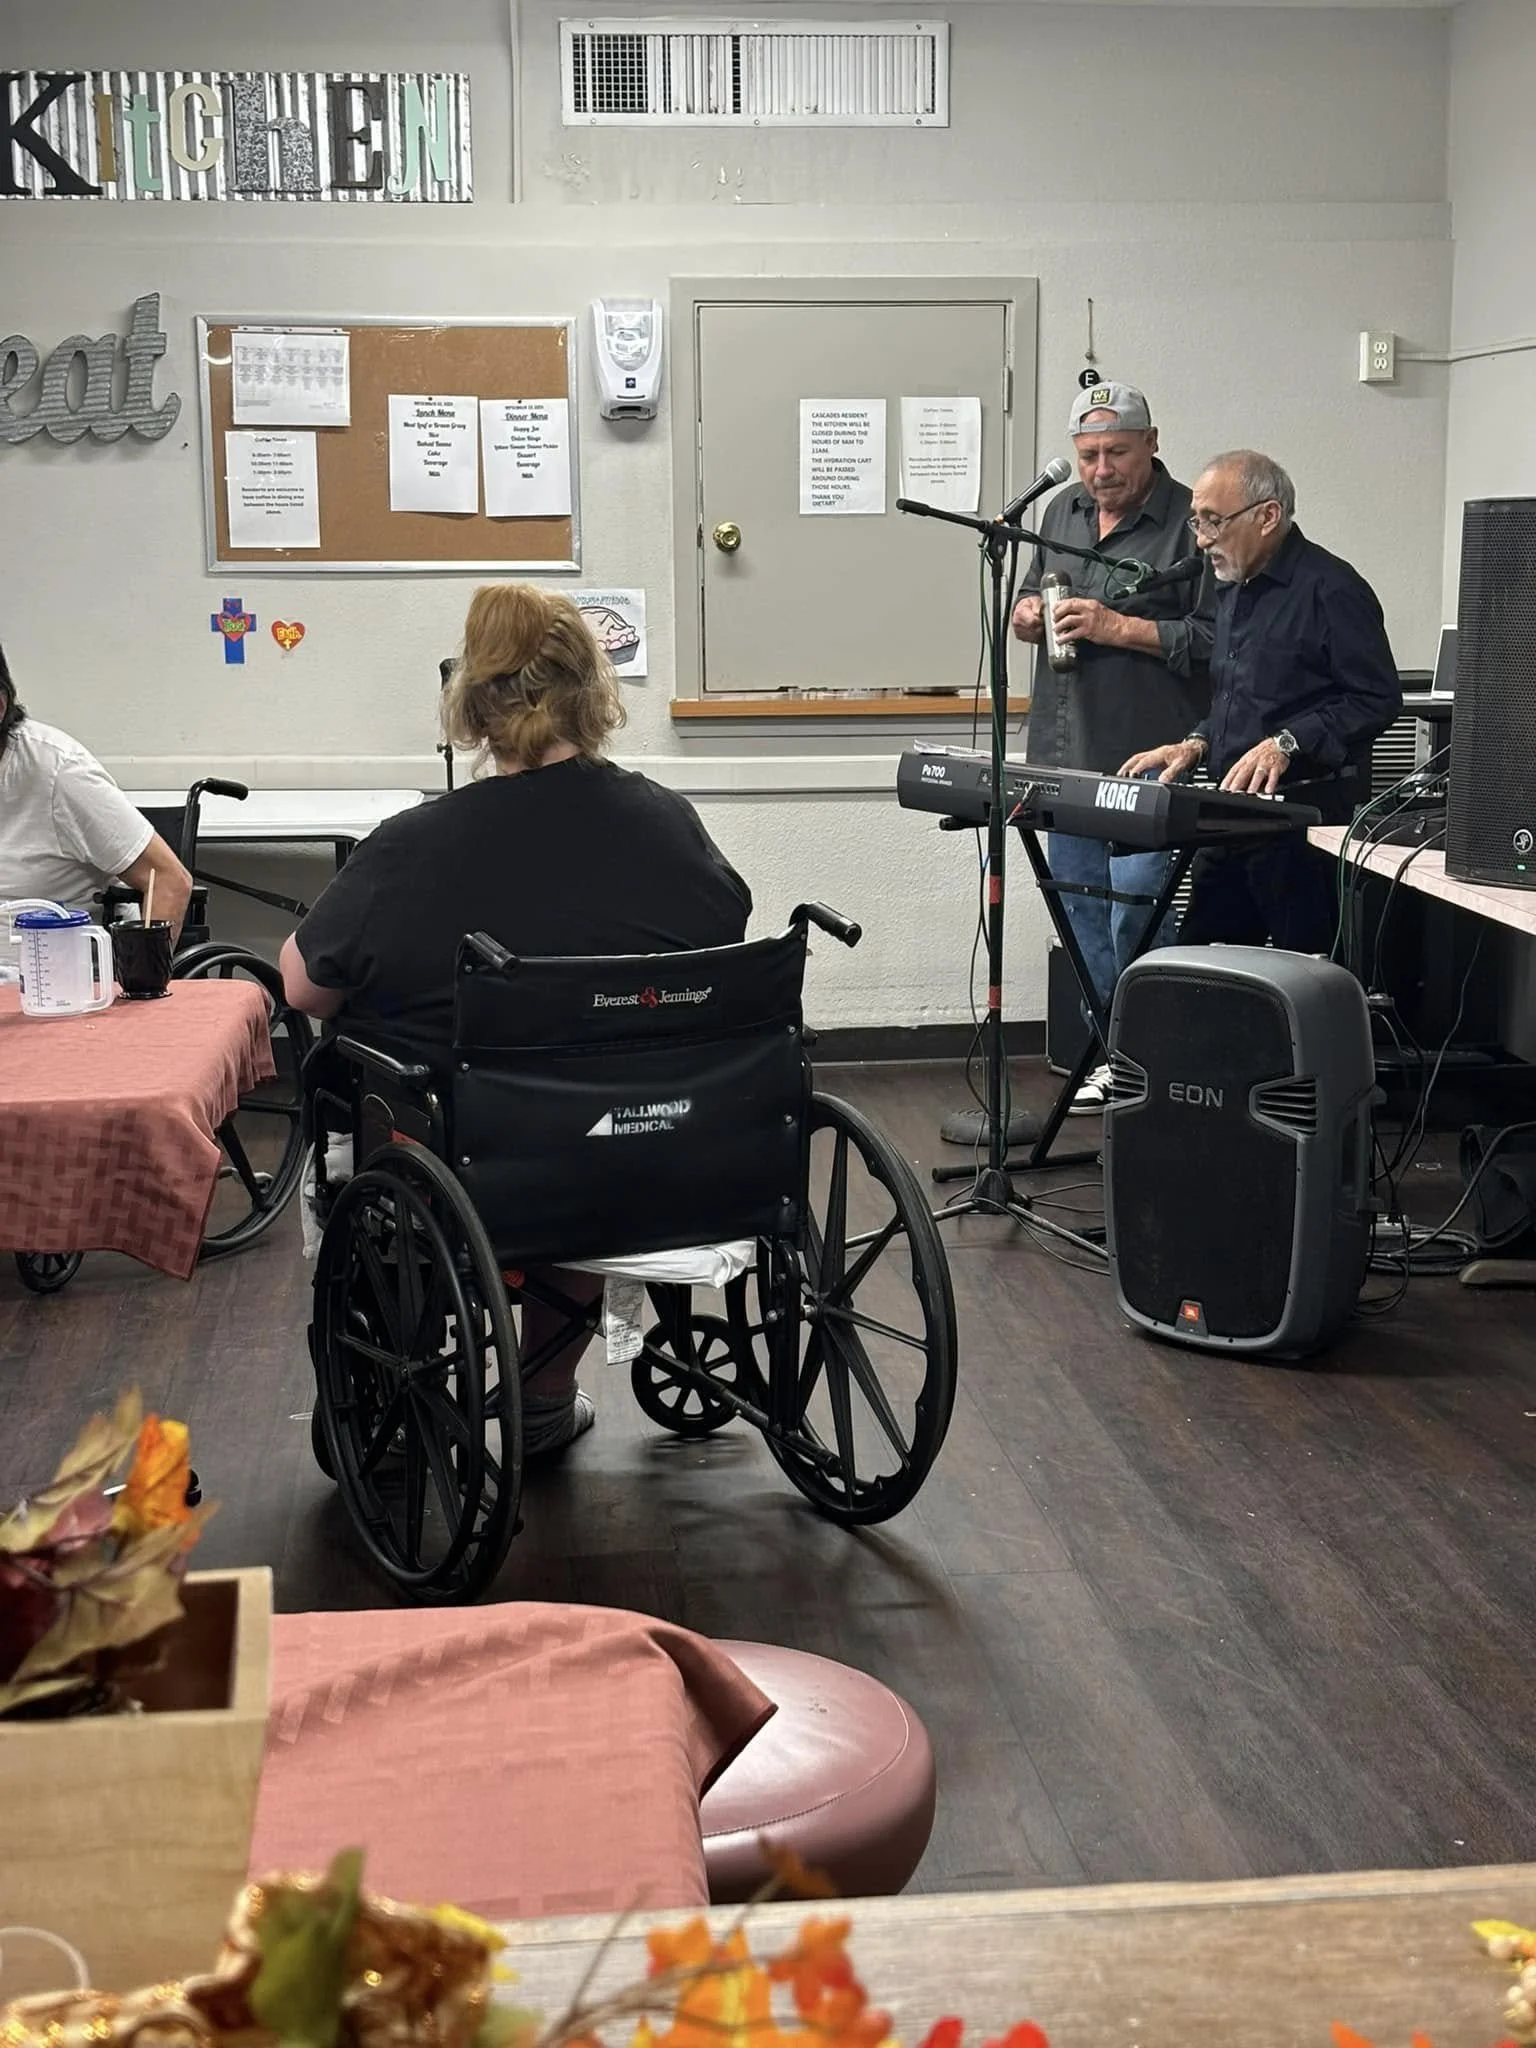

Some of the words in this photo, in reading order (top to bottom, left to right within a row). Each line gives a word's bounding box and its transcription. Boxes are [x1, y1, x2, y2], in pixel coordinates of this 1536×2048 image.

[0, 290, 183, 444] eat
[1084, 372, 1096, 387] E
[416, 409, 435, 418] Lunch
[437, 409, 455, 418] Menu
[505, 412, 528, 421] Dinner
[530, 412, 548, 421] Menu
[921, 764, 946, 778] Pa700
[1094, 781, 1141, 812] KORG
[593, 993, 640, 1008] Everest
[658, 987, 709, 1004] Jennings
[1168, 1081, 1224, 1108] EON
[613, 1119, 675, 1136] MEDICAL
